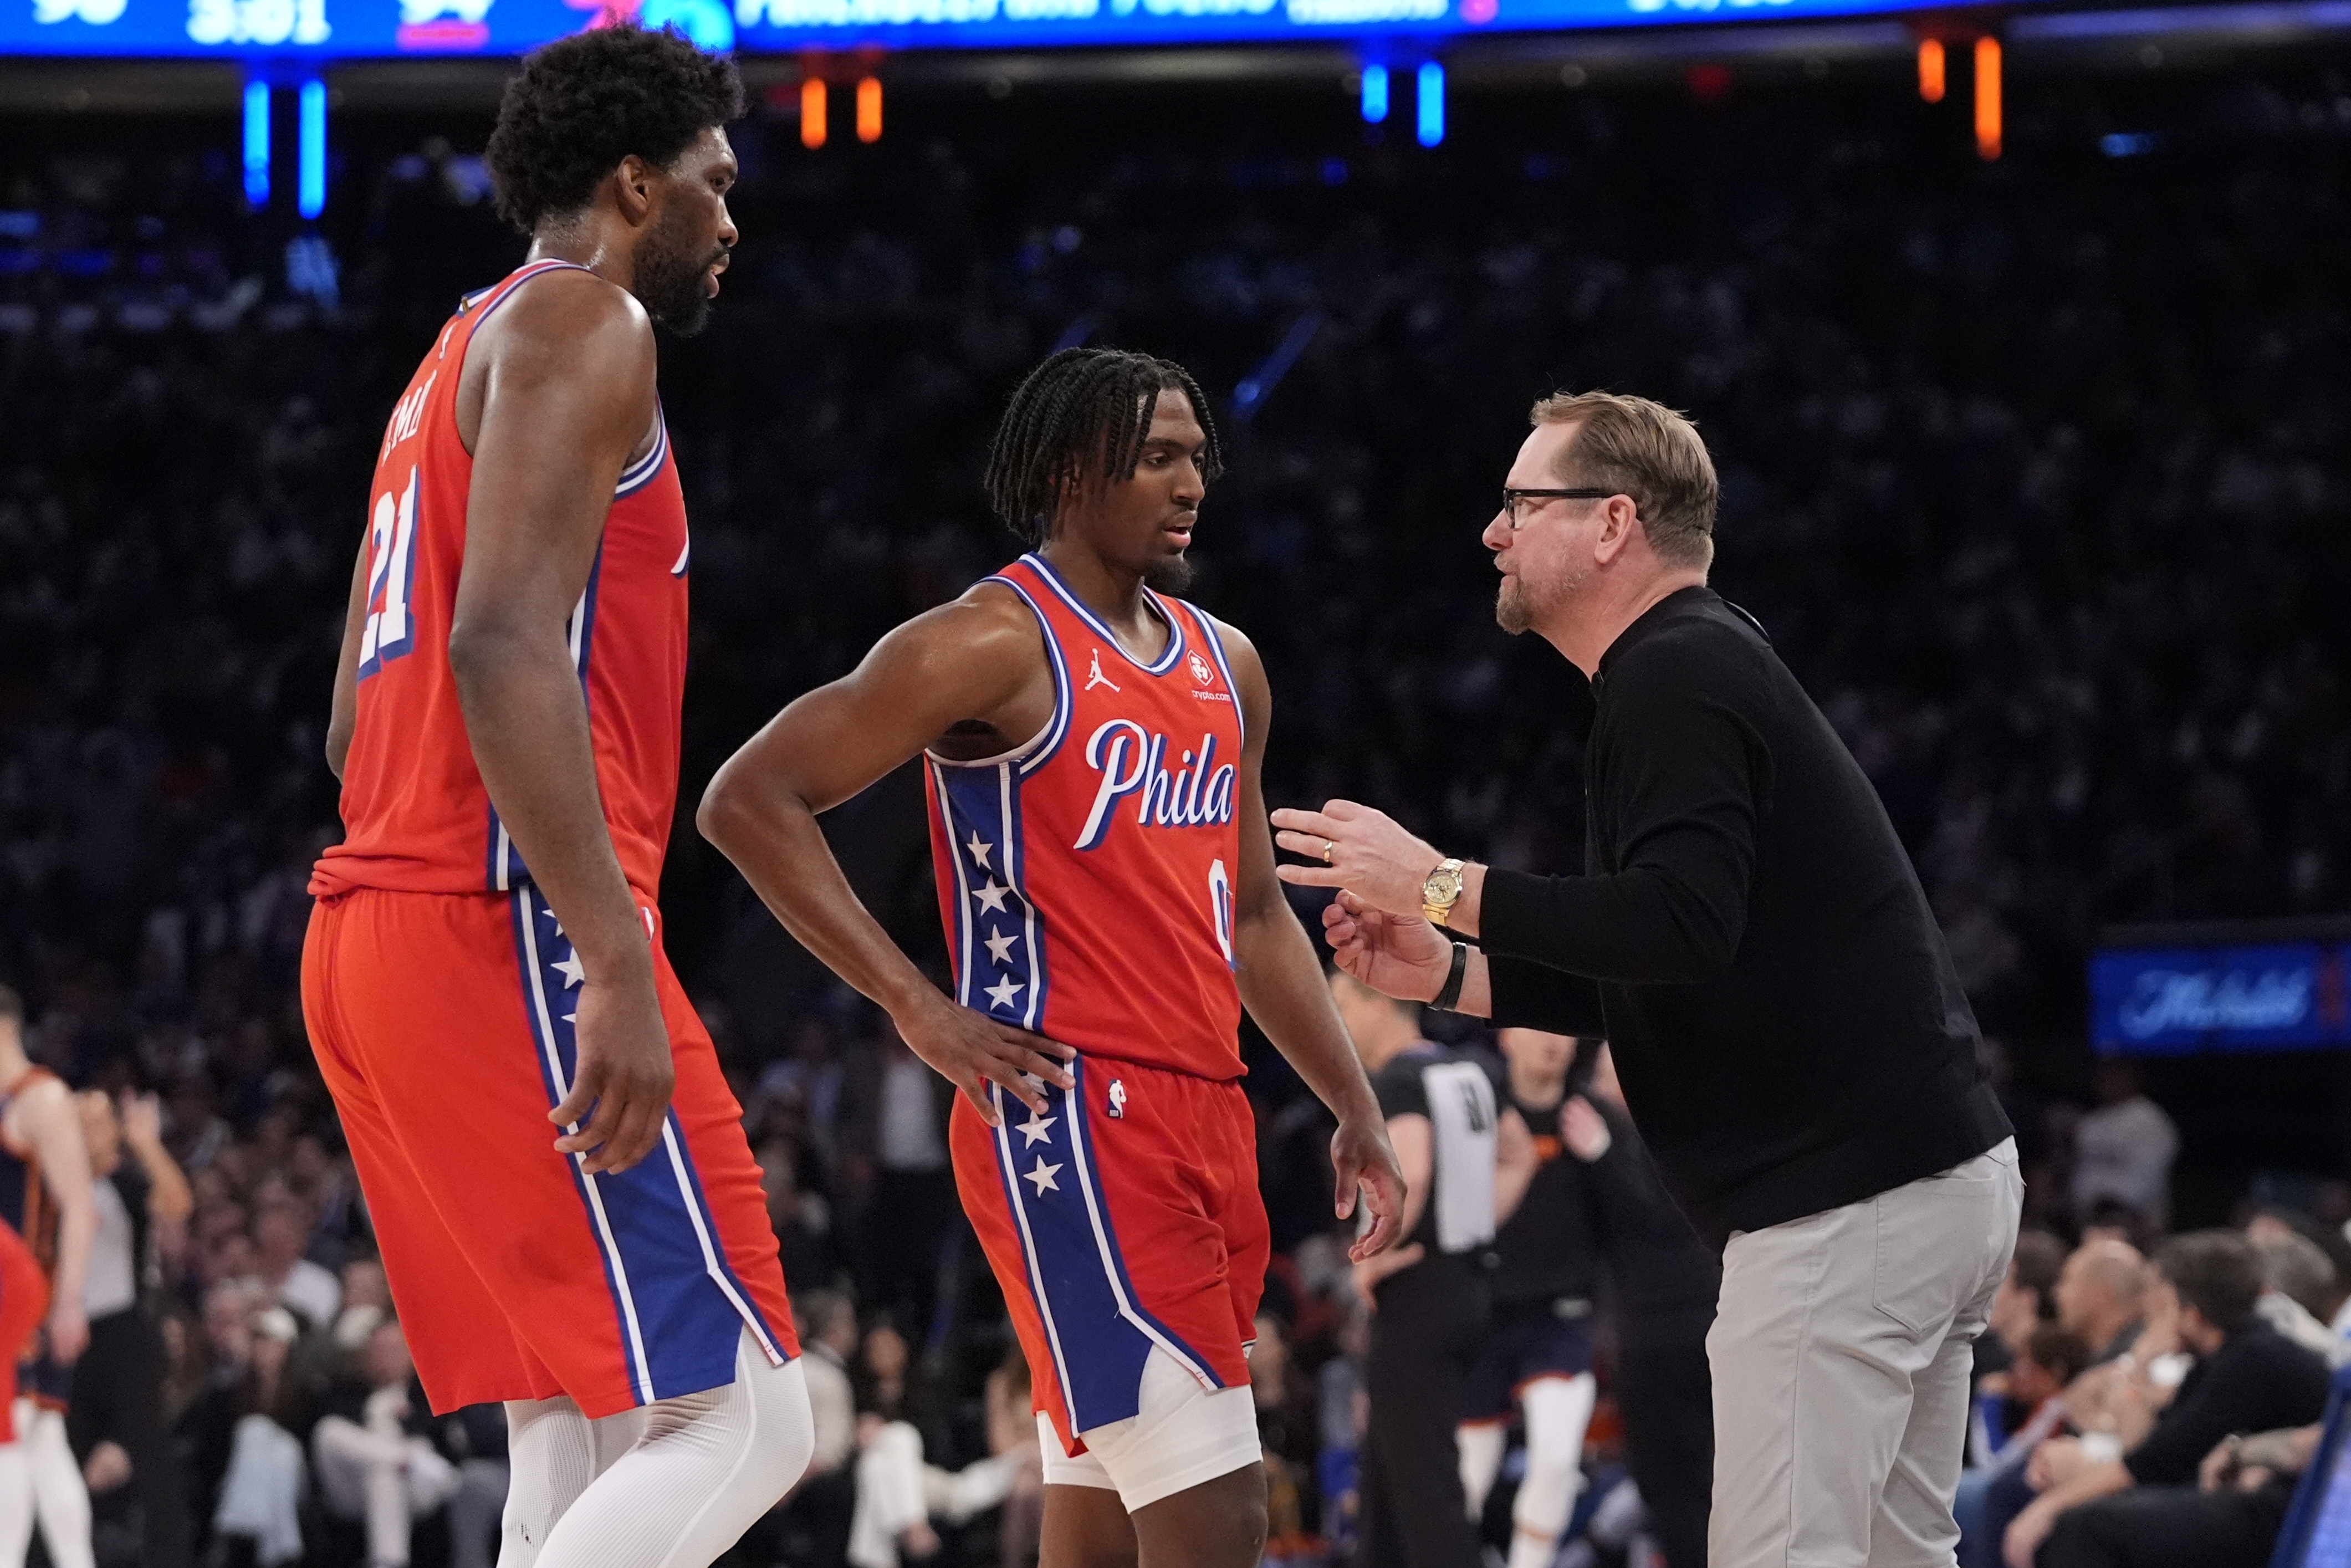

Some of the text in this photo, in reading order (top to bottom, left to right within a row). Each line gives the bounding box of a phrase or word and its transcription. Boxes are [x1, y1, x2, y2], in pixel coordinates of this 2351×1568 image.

[357, 464, 418, 682] 21
[1192, 689, 1231, 702] crypto.com
[1074, 719, 1235, 851] Phila
